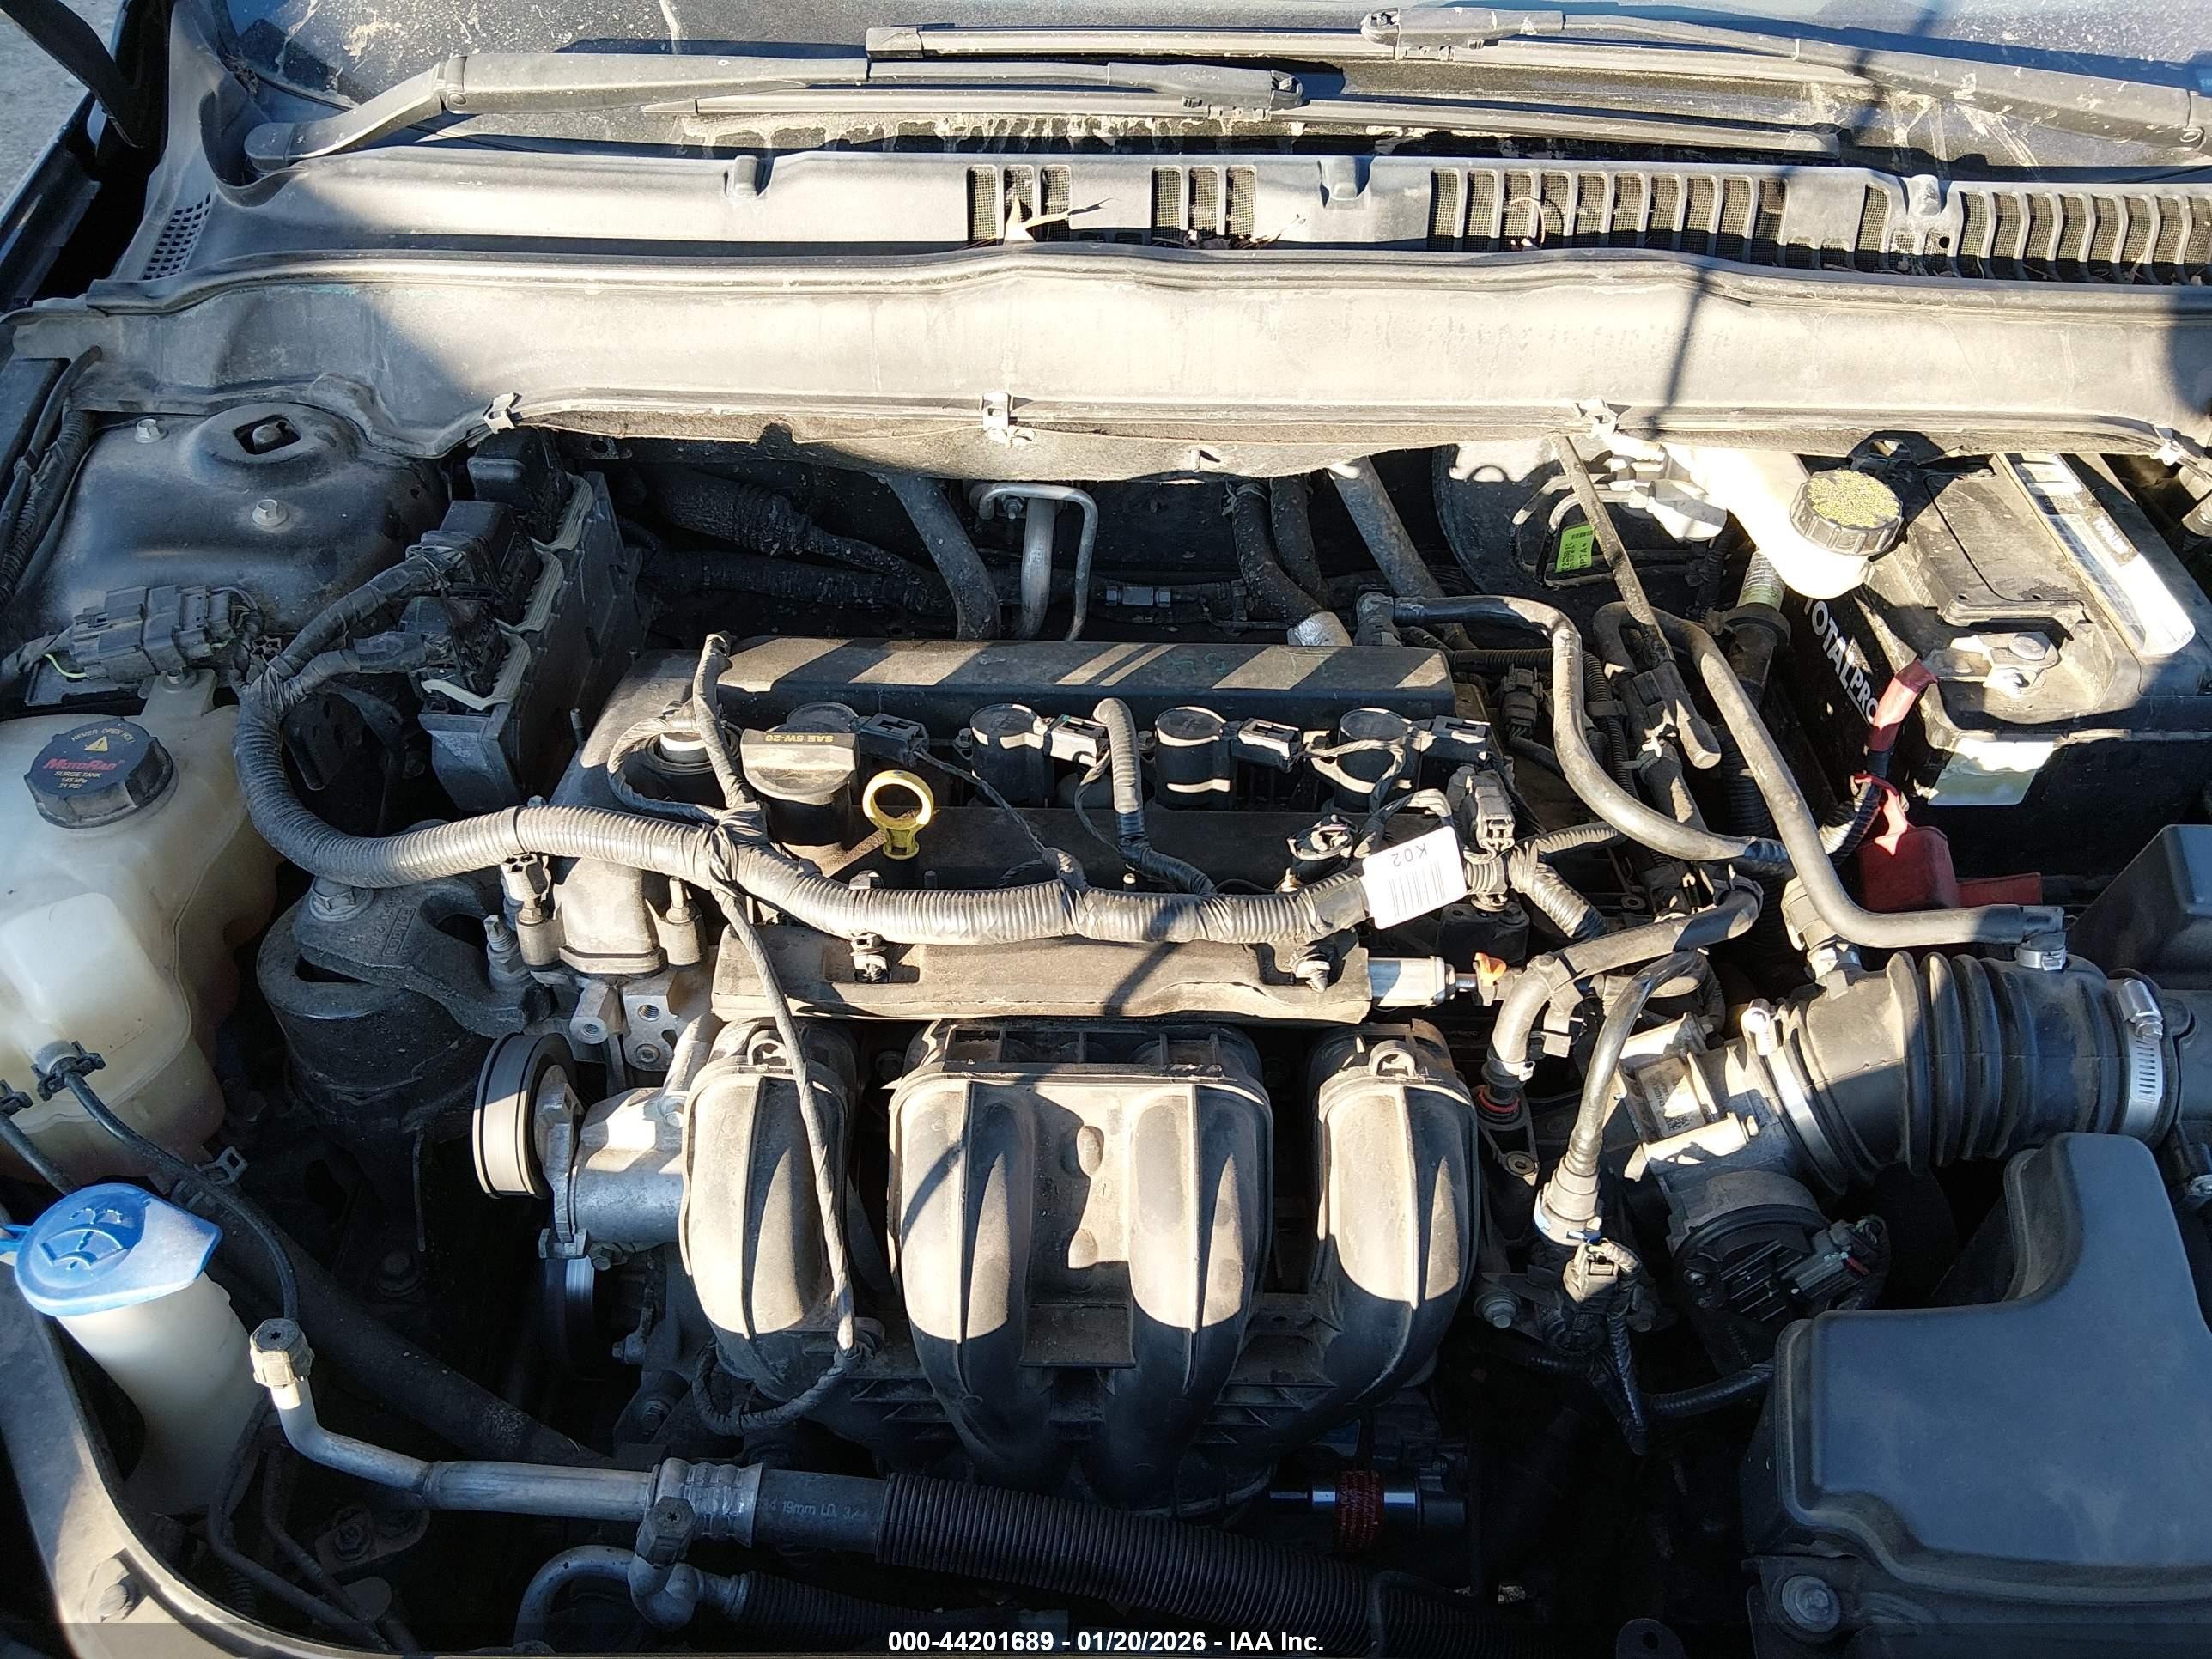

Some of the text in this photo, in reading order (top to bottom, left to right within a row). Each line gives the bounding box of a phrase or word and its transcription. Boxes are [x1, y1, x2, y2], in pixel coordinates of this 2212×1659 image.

[71, 730, 98, 742] NEVER
[765, 733, 835, 743] SAE 5W-20
[781, 1500, 817, 1516] 19mm
